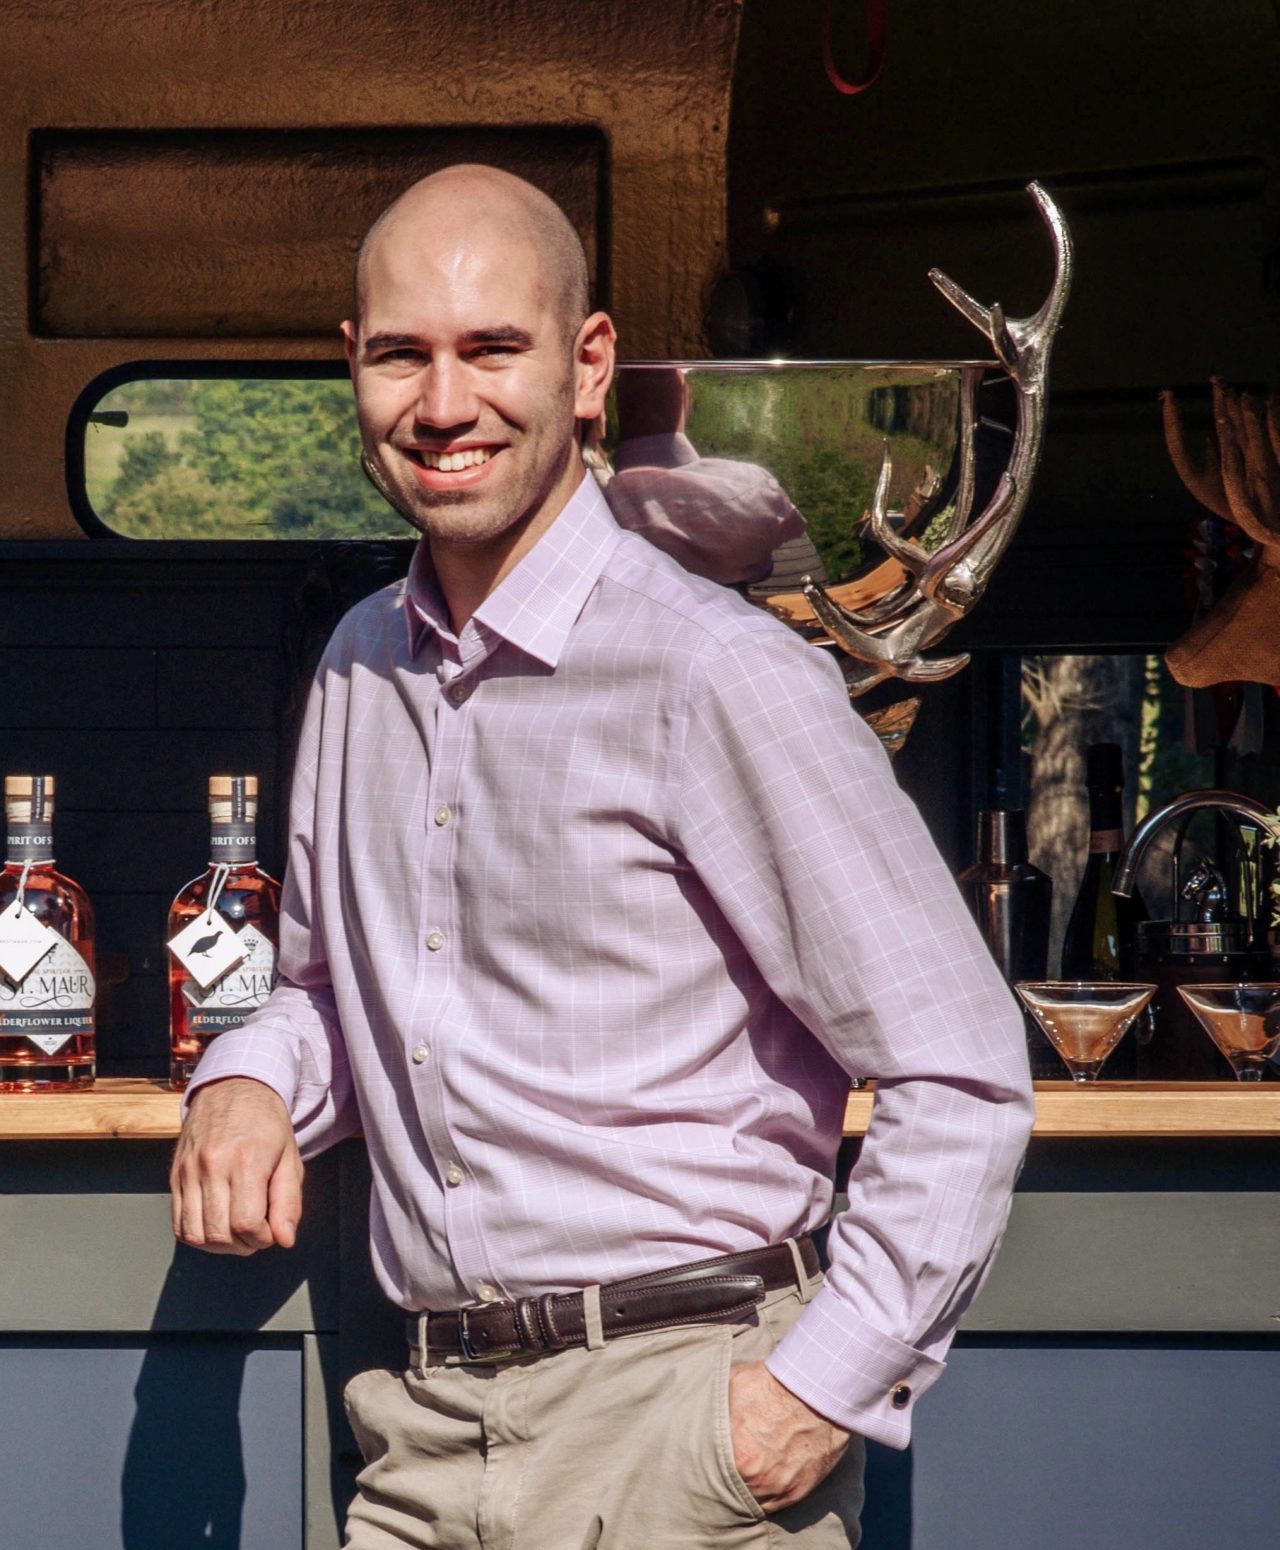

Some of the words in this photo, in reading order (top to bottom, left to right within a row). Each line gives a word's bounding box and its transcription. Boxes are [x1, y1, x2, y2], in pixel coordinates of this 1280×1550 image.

[7, 836, 33, 845] PIRIT
[33, 836, 46, 845] OF
[210, 836, 235, 845] PIRIT
[236, 836, 249, 845] OF
[39, 975, 92, 1000] MAUR
[239, 974, 272, 998] MA
[192, 1015, 246, 1025] ELDERFLO
